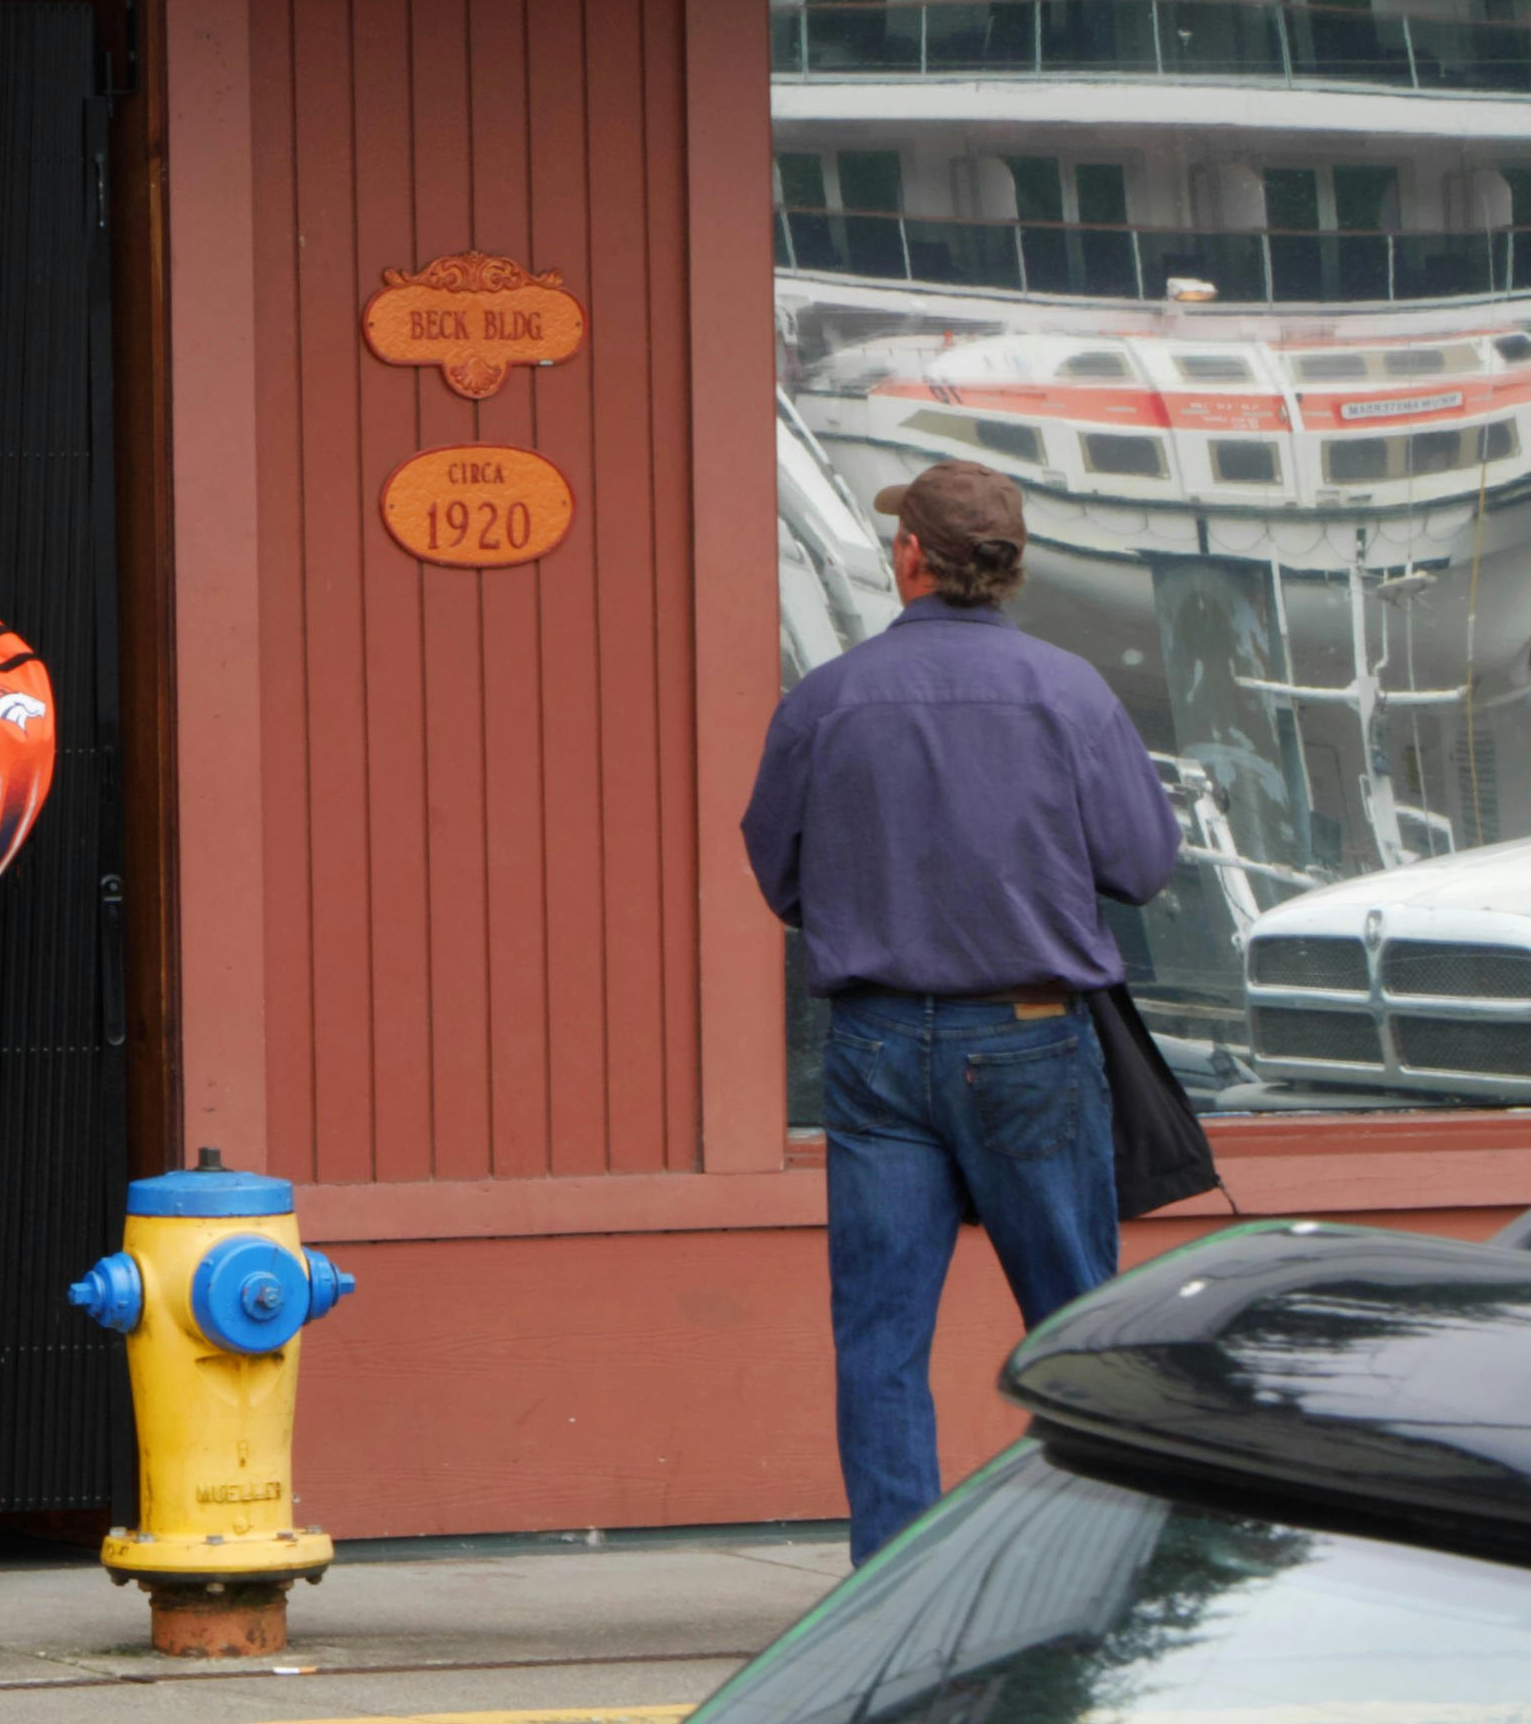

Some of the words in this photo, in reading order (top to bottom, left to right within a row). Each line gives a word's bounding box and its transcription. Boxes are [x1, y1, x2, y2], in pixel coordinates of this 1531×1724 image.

[410, 310, 470, 340] BECK
[483, 310, 543, 340] BLDG
[448, 462, 505, 484] CIRCA
[427, 500, 531, 550] 1920
